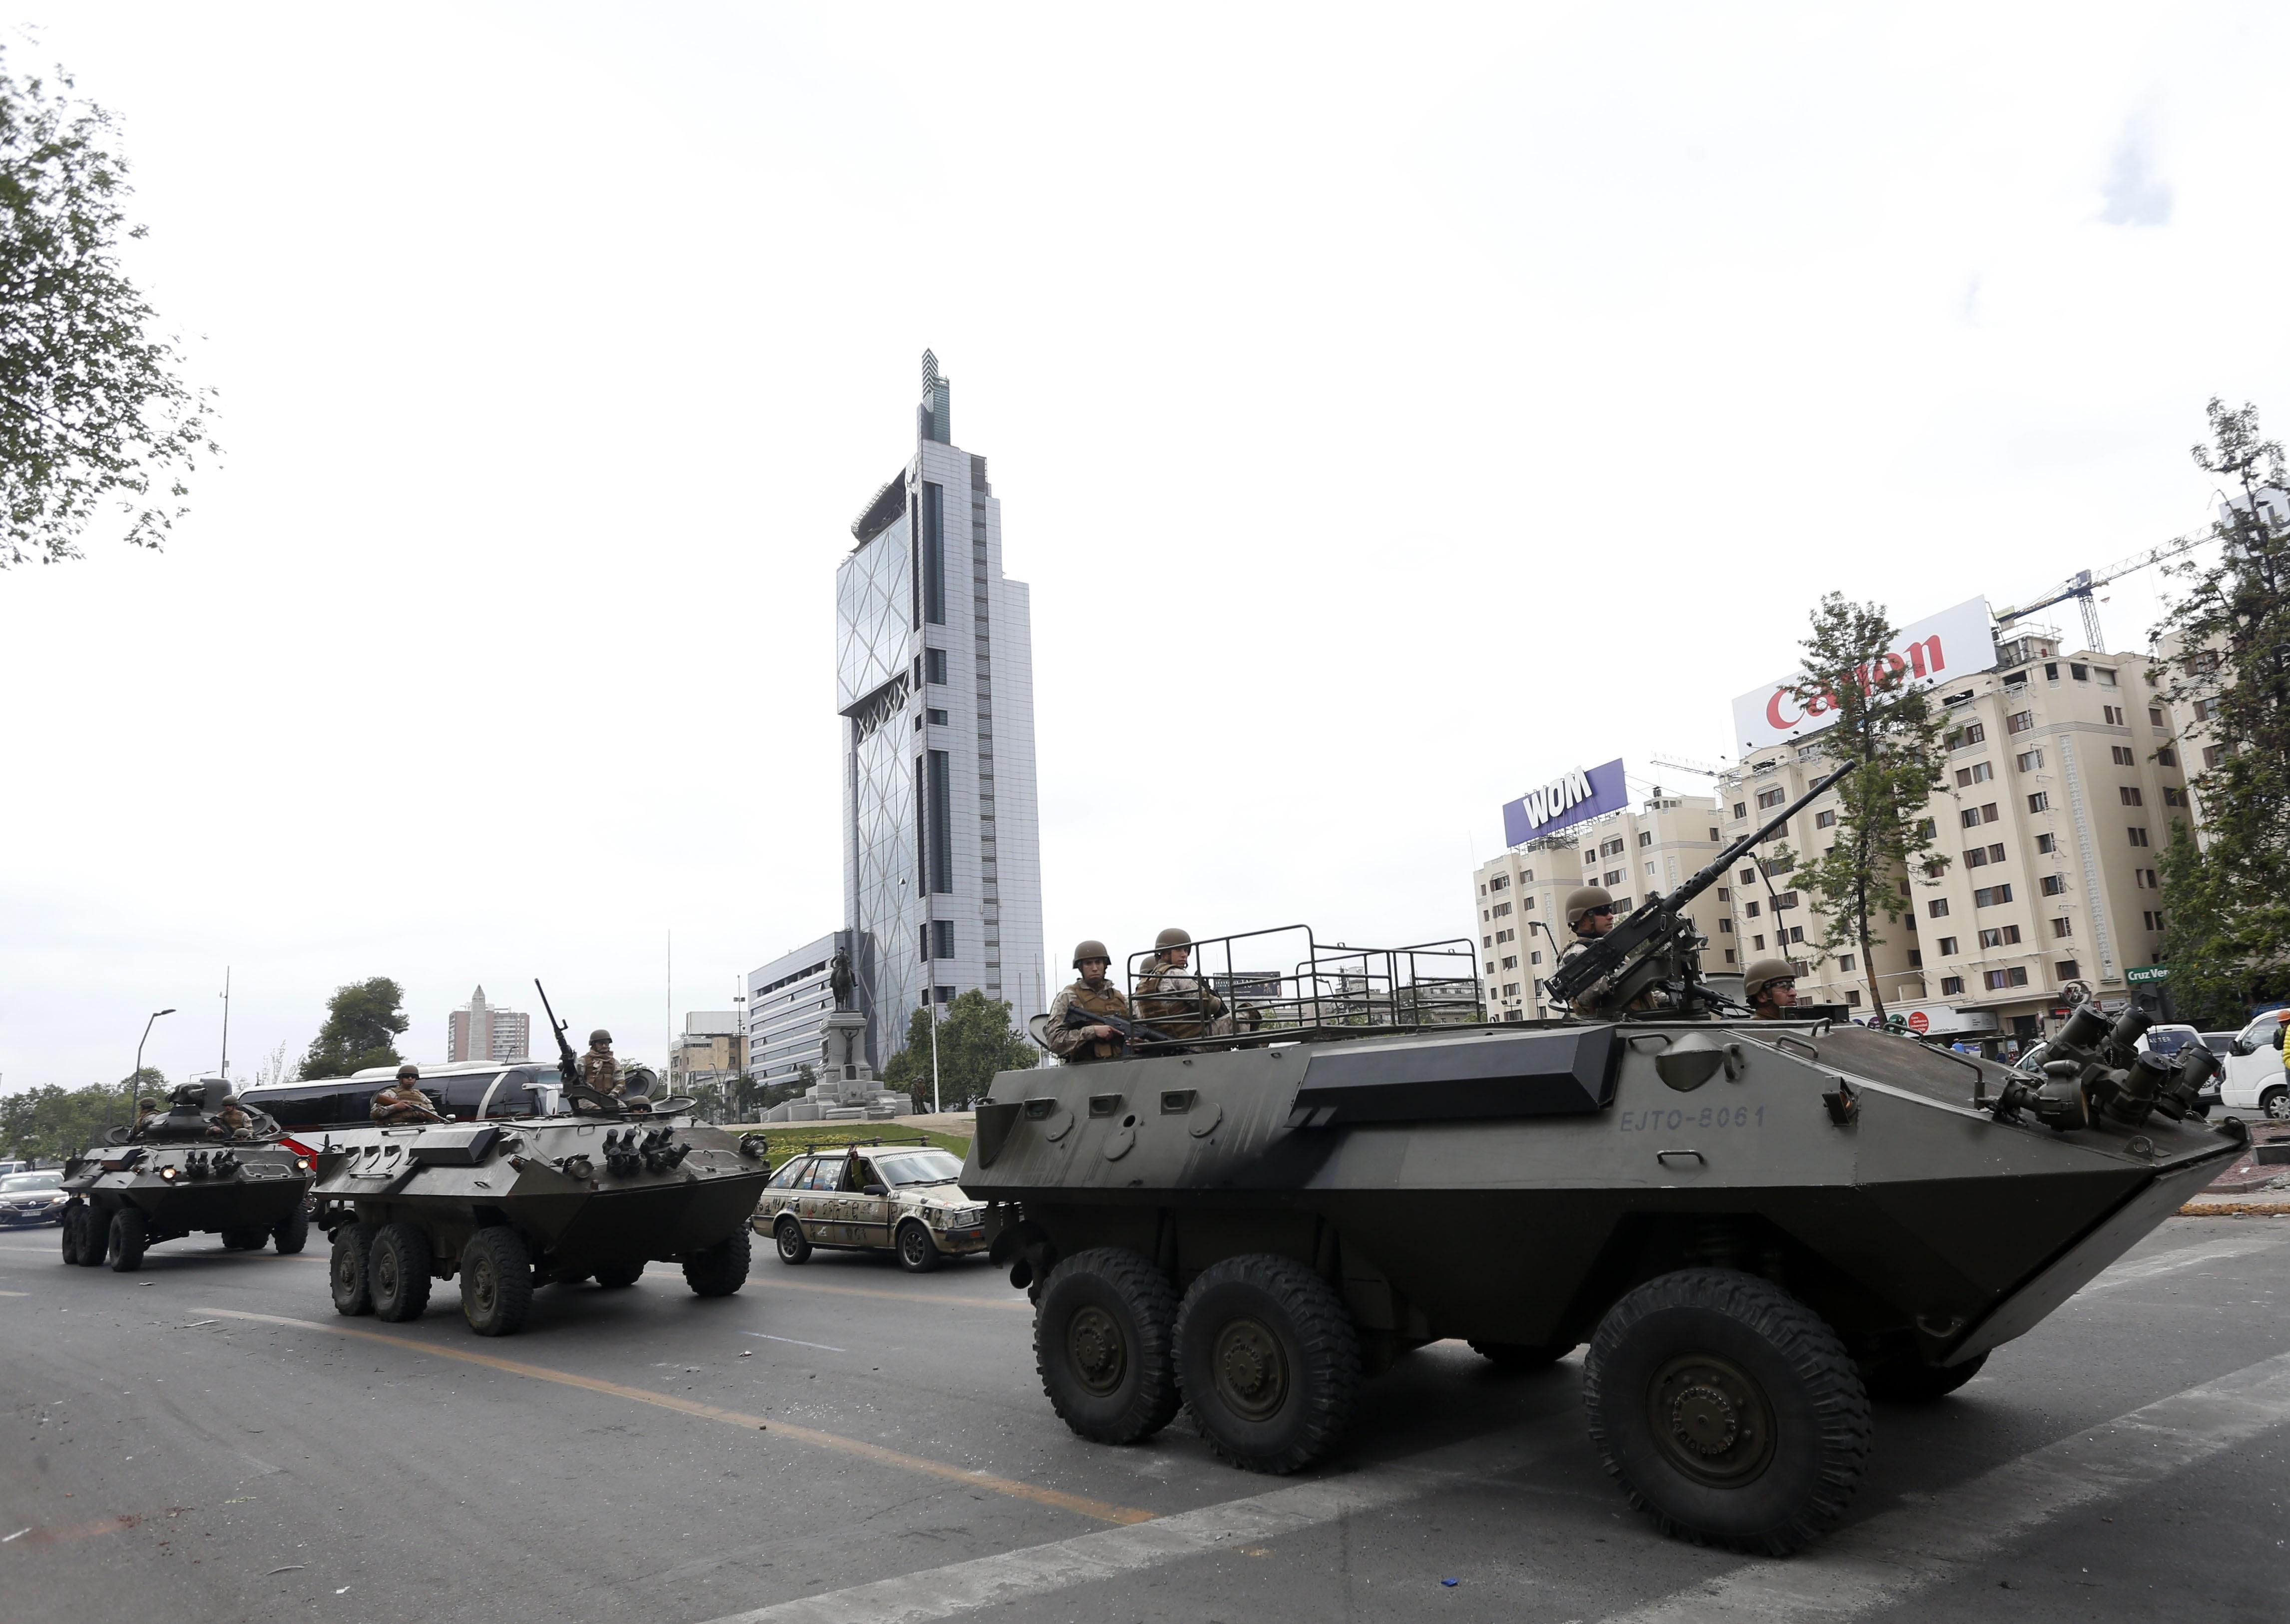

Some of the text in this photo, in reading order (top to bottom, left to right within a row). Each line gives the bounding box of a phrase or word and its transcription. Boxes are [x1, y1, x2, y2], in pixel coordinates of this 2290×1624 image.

[1522, 766, 1592, 829] WOM
[2128, 968, 2170, 981] Cruz Ver
